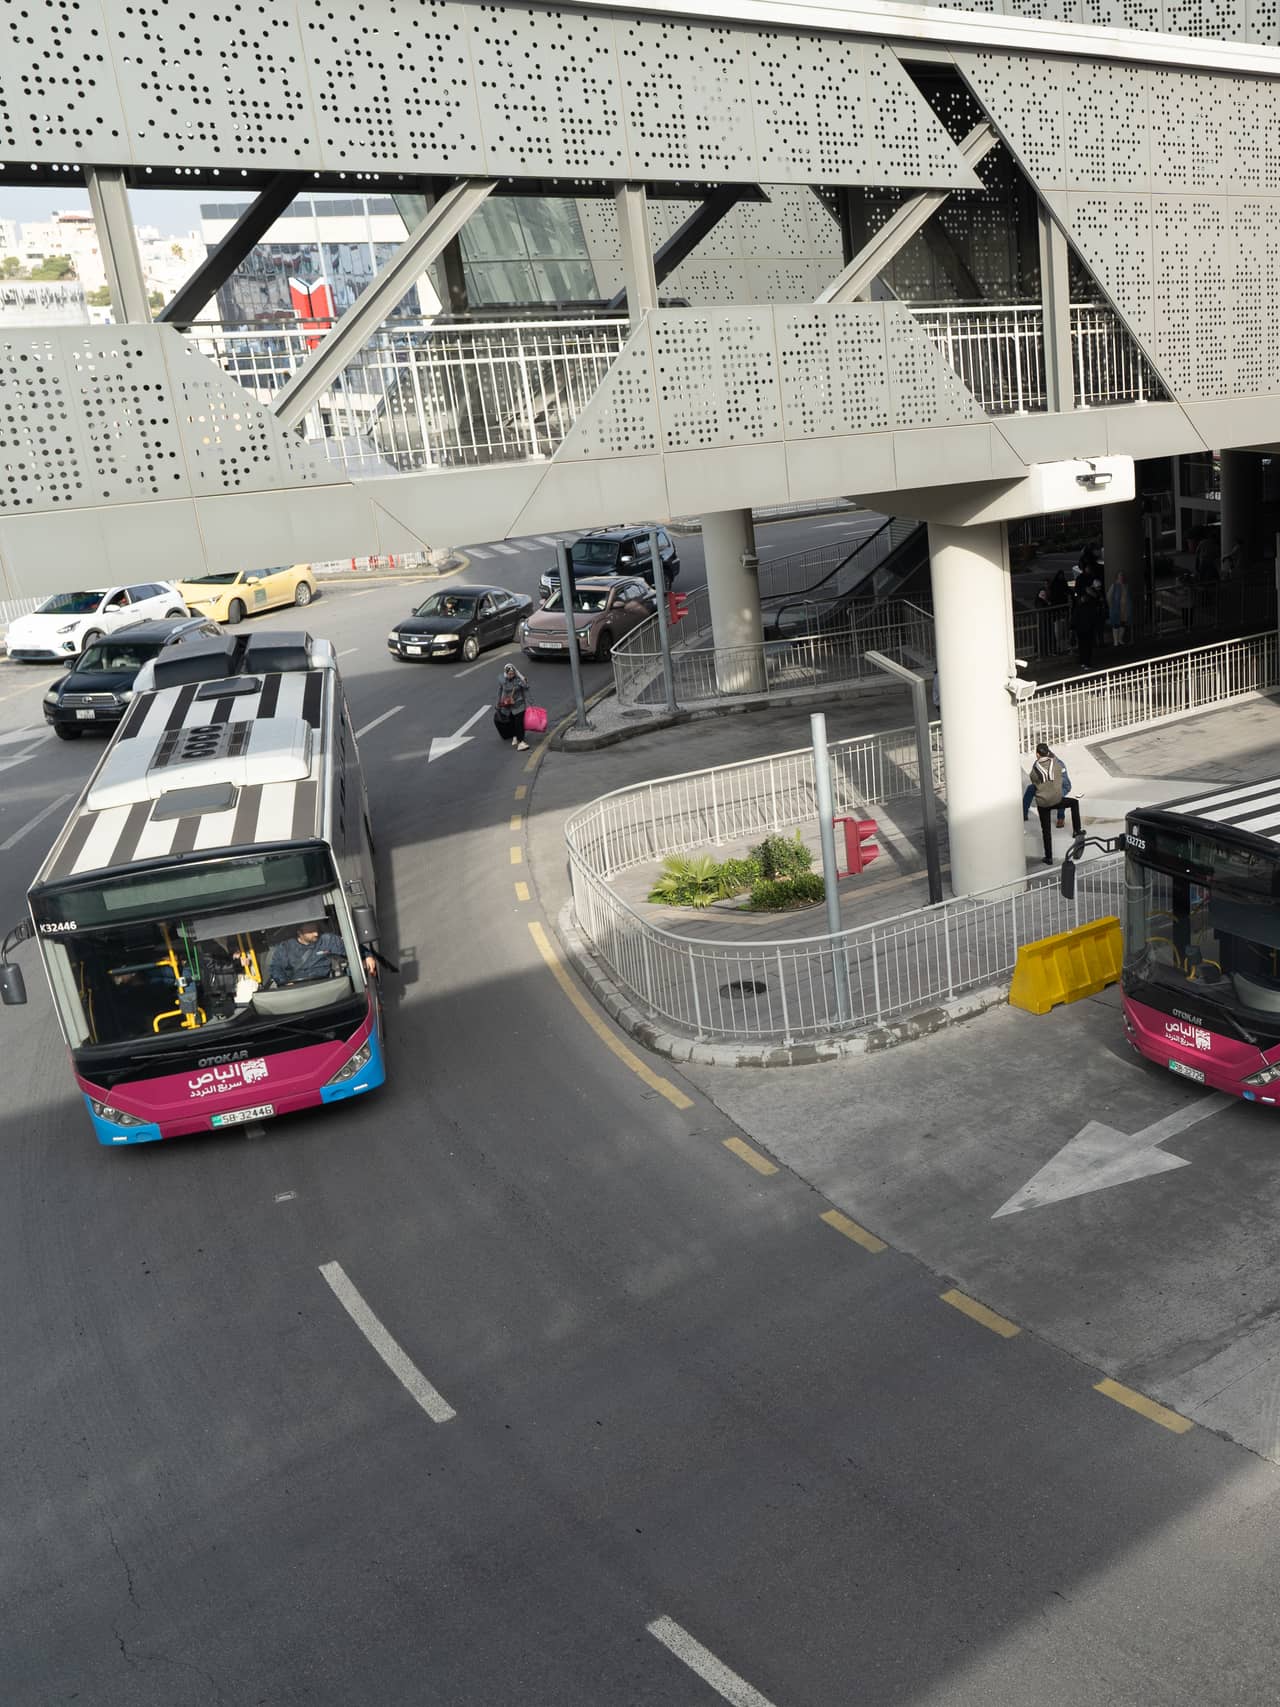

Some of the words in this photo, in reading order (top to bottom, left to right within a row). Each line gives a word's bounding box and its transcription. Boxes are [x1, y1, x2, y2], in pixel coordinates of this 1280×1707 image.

[39, 921, 76, 933] K32446
[1172, 1008, 1202, 1025] OTOKAR
[1165, 1022, 1195, 1039] الباص
[198, 1050, 248, 1067] OTOKAR
[188, 1064, 240, 1089] الباص
[190, 1086, 216, 1097] التردد
[217, 1081, 242, 1092] سريع
